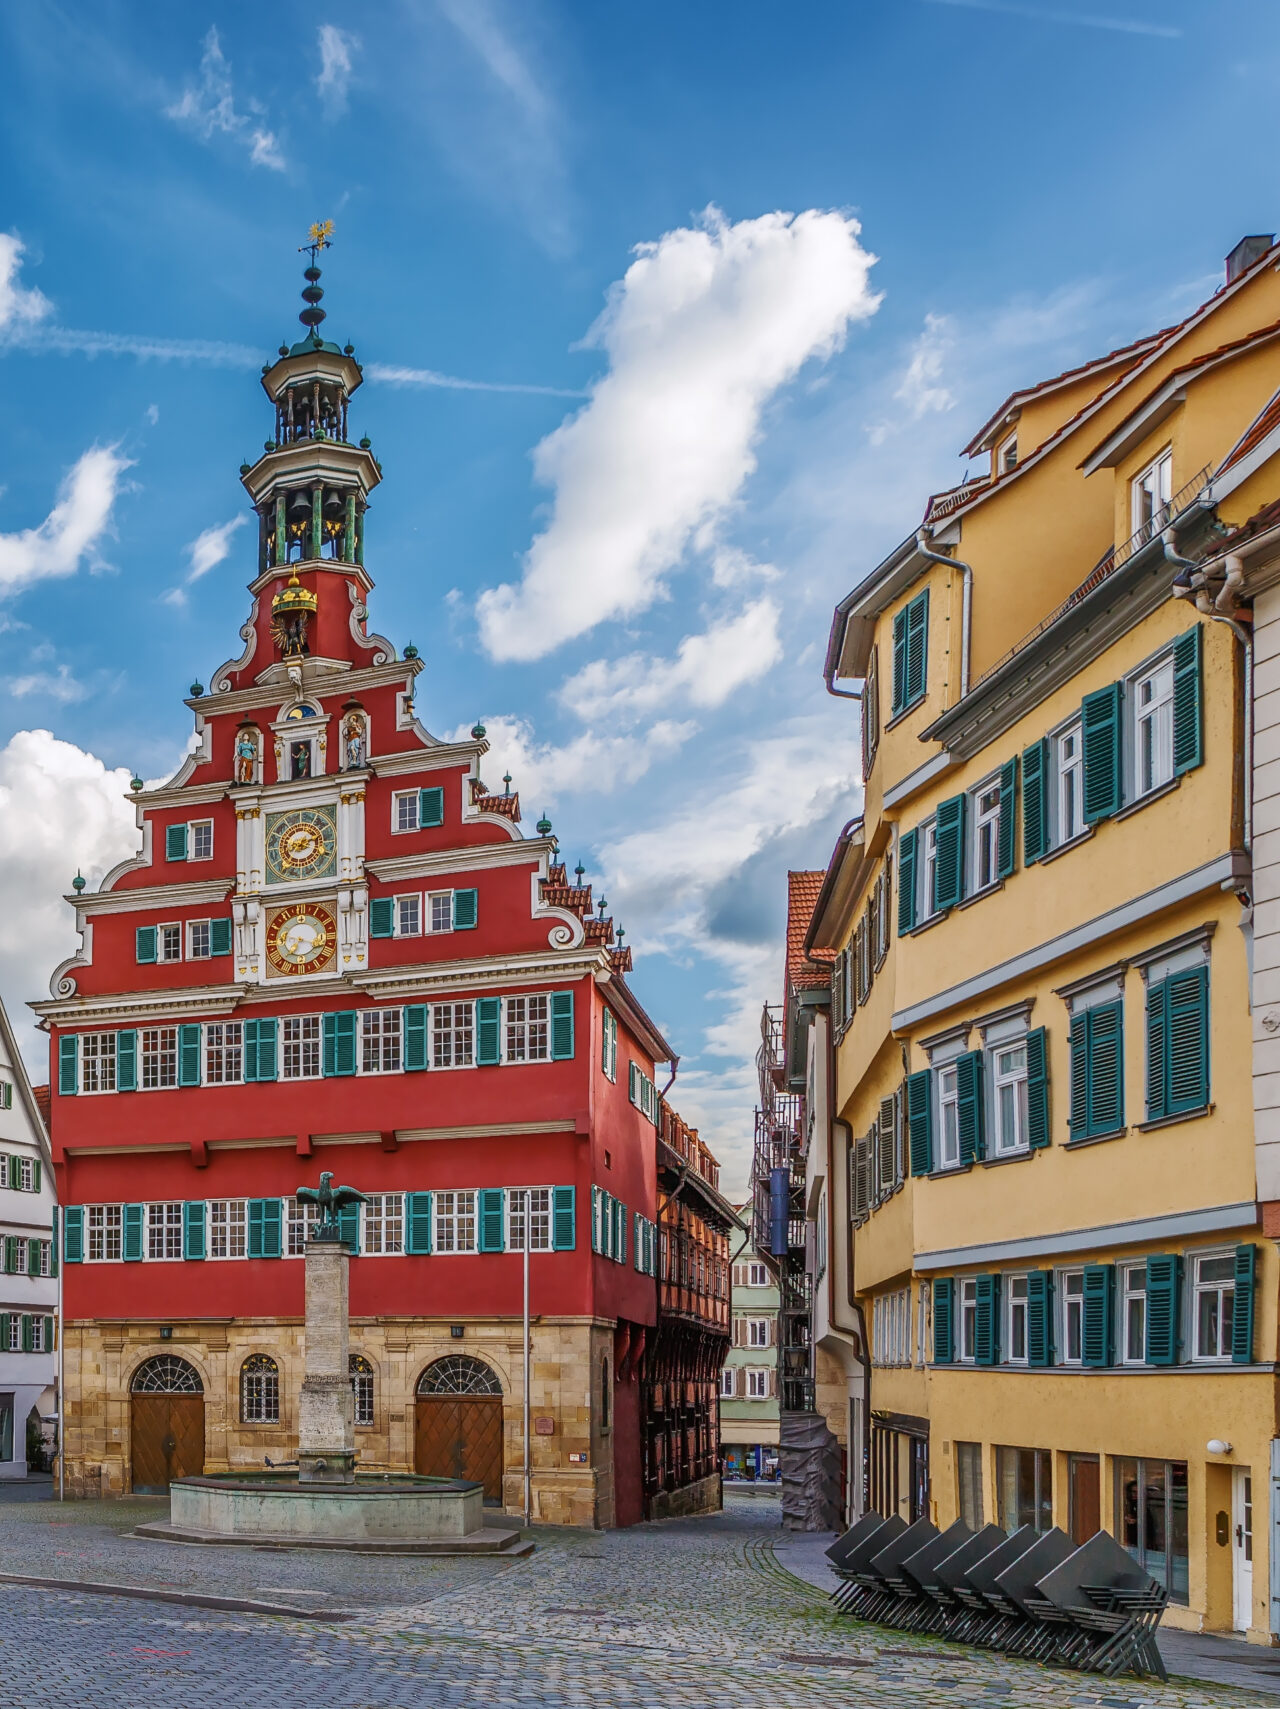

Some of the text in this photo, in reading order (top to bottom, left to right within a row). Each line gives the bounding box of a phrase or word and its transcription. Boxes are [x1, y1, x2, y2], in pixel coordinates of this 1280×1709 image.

[296, 904, 306, 914] XII
[313, 907, 319, 916] I
[281, 910, 291, 920] XI
[322, 917, 331, 925] II
[313, 959, 320, 967] V
